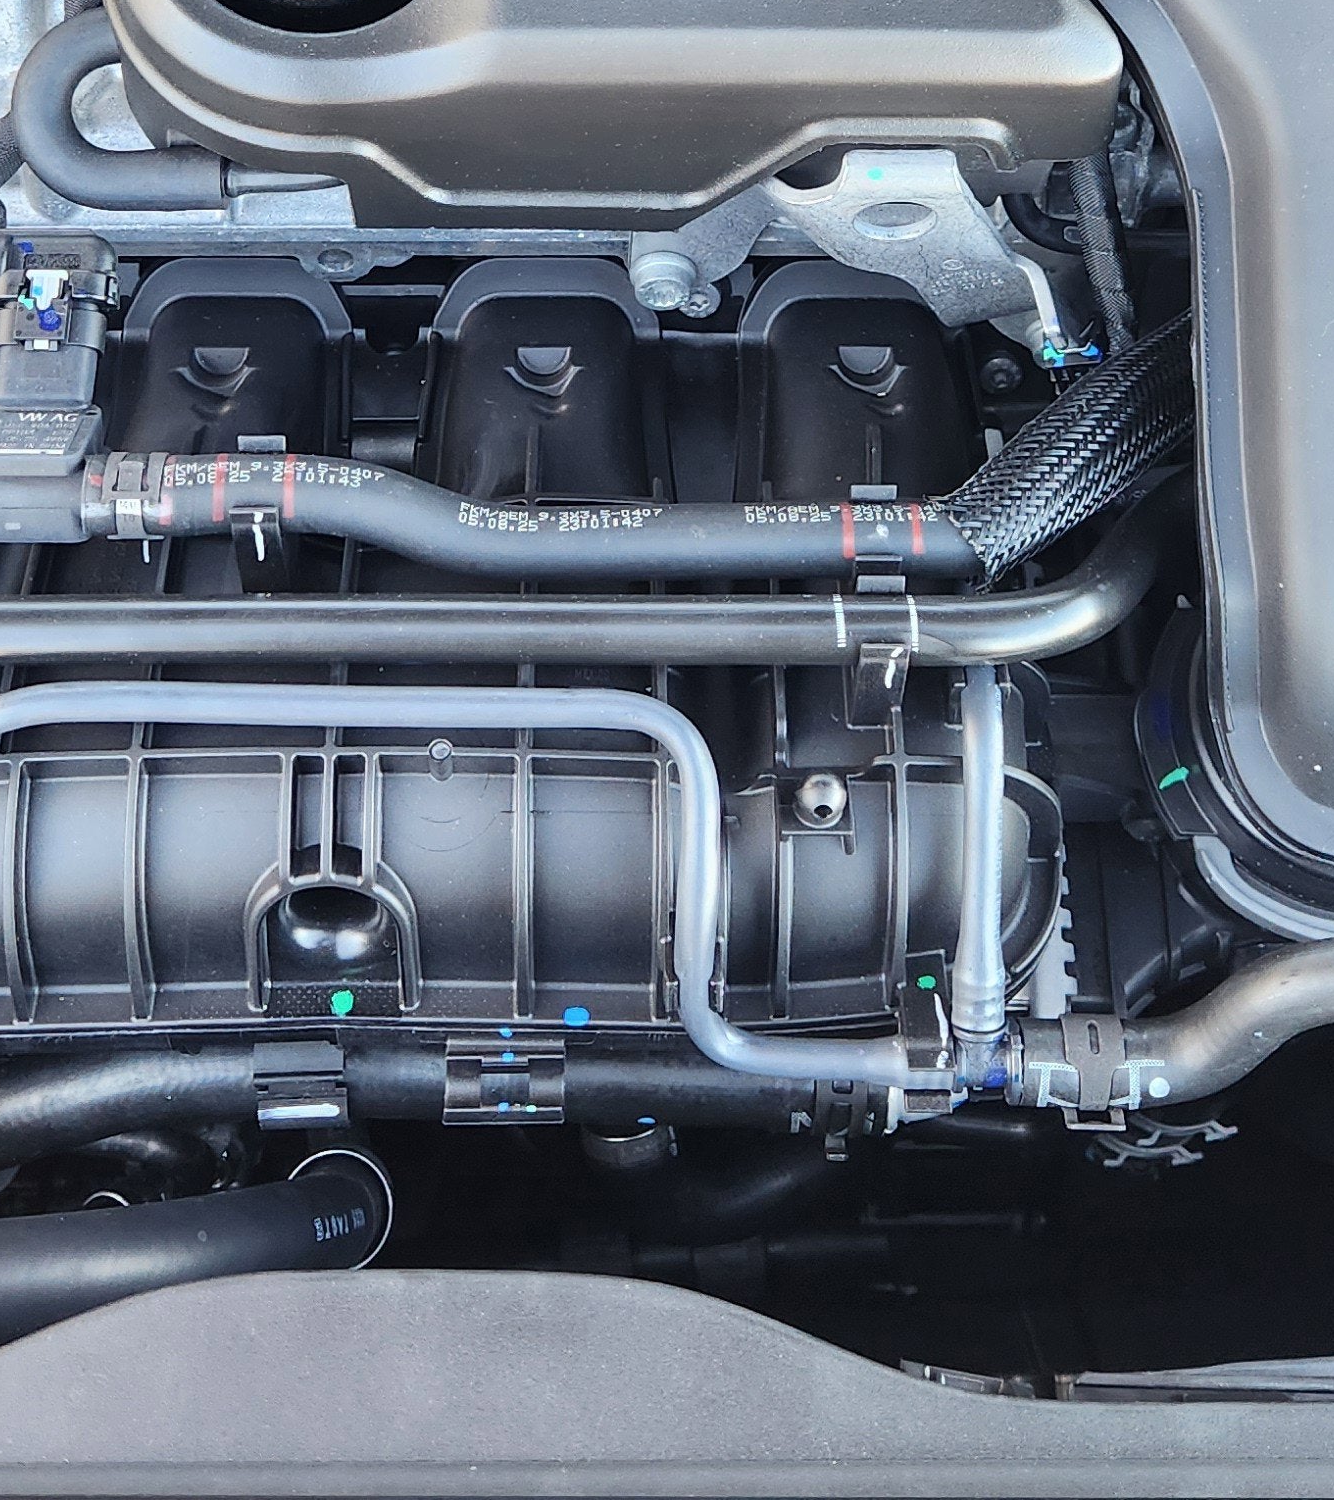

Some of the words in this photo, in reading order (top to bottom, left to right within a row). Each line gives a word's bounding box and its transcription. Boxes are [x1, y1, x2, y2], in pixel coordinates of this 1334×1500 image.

[17, 412, 48, 423] VW
[49, 412, 80, 423] AG
[458, 511, 540, 533] 05.08.25
[556, 515, 646, 533] 23:01:42
[744, 510, 833, 525] 05.08.25
